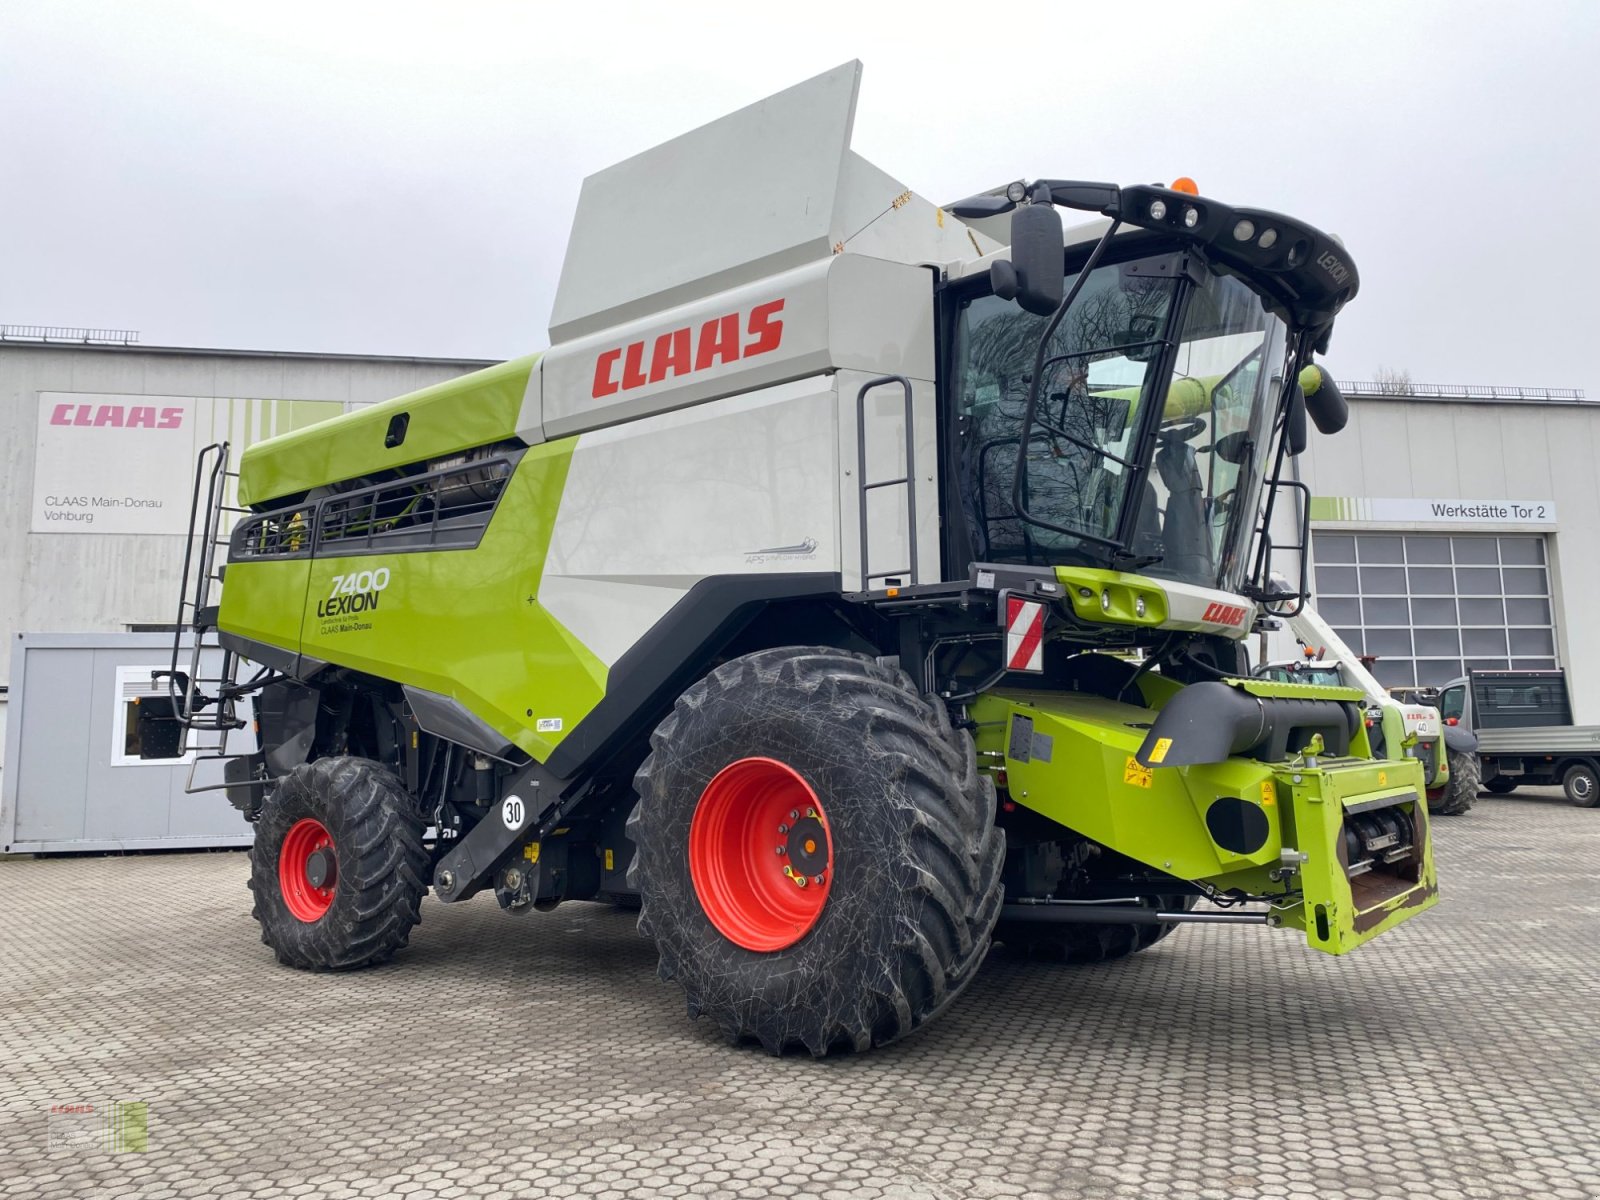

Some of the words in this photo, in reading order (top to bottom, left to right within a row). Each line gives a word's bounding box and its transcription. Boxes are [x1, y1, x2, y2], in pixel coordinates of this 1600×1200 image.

[1317, 250, 1350, 285] LEXION
[592, 298, 785, 399] CLAAS
[50, 404, 184, 429] CLAAS
[45, 496, 88, 507] CLAAS
[91, 497, 163, 508] Main-Donau
[1431, 503, 1508, 518] Werkstätte
[1511, 505, 1533, 518] Tor
[1537, 505, 1546, 519] 2
[44, 510, 94, 523] Vohburg
[330, 567, 390, 599] 7400
[317, 591, 379, 618] LEXION
[1202, 602, 1248, 626] CLAAS
[321, 625, 339, 635] CLAAS
[340, 622, 372, 632] Main-Donau
[506, 802, 521, 823] 30
